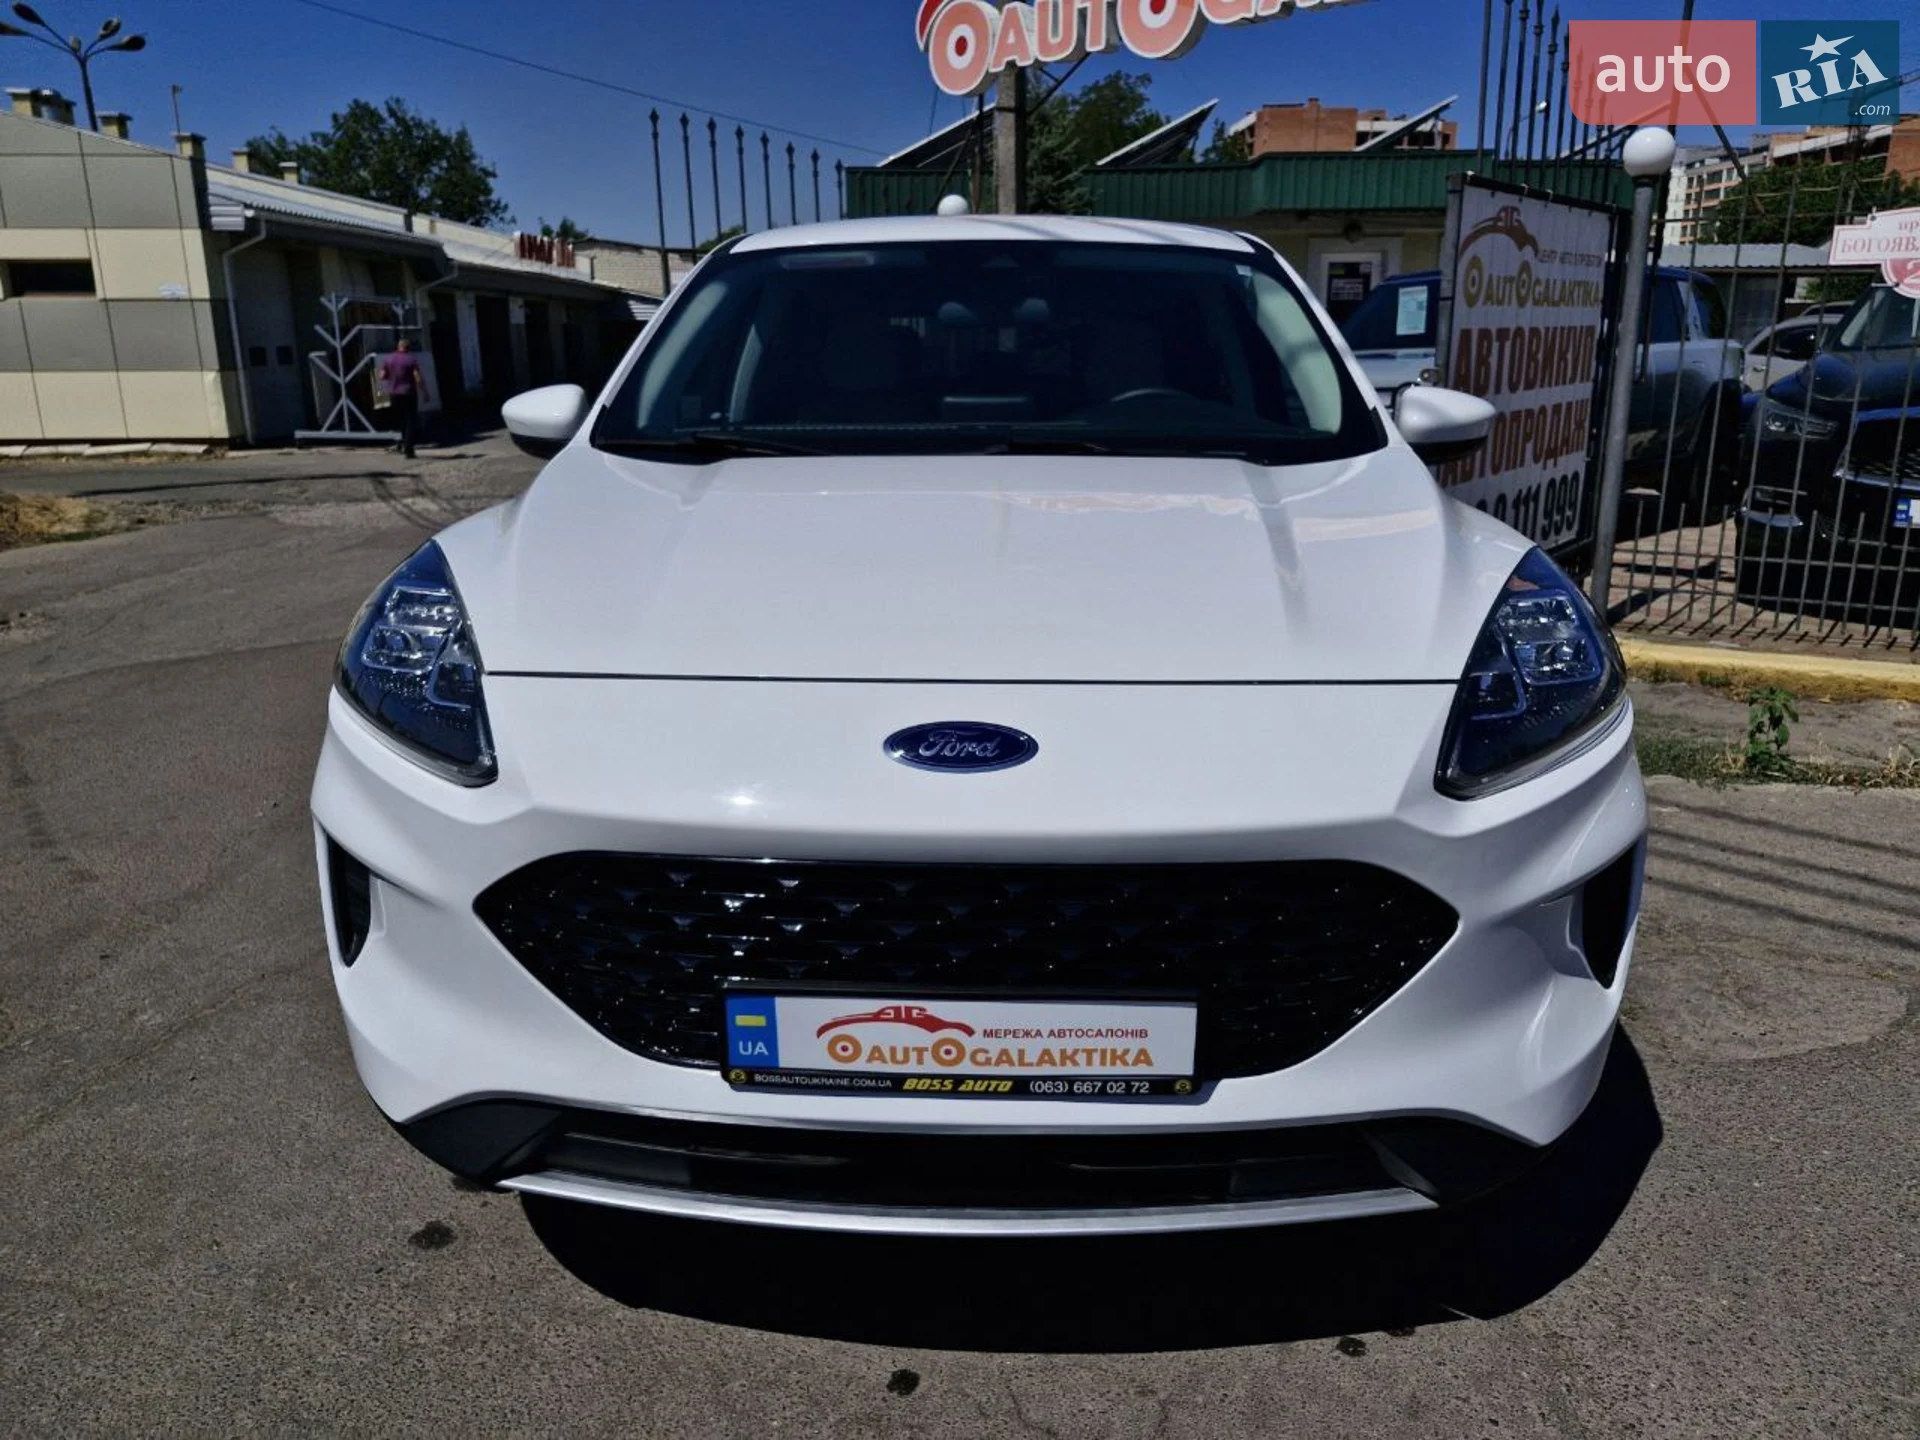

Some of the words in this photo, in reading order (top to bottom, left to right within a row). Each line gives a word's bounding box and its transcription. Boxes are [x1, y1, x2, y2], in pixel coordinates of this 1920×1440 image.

[1453, 325, 1596, 397] АВТОВИКУП
[1541, 470, 1581, 541] 999
[918, 729, 1001, 757] Ford
[982, 1028, 1043, 1039] МЕРЕЖА
[1047, 1028, 1149, 1039] АВТОСАЛОНІВ
[738, 1041, 769, 1056] UA
[754, 1073, 892, 1088] BOSSAUTOUKRAINE.COM.UA
[902, 1078, 954, 1091] BOSS
[957, 1079, 1014, 1092] AUTO
[1029, 1080, 1069, 1094] (063)
[1073, 1081, 1102, 1094] 667
[1106, 1082, 1127, 1094] 02
[1131, 1082, 1150, 1094] 72
